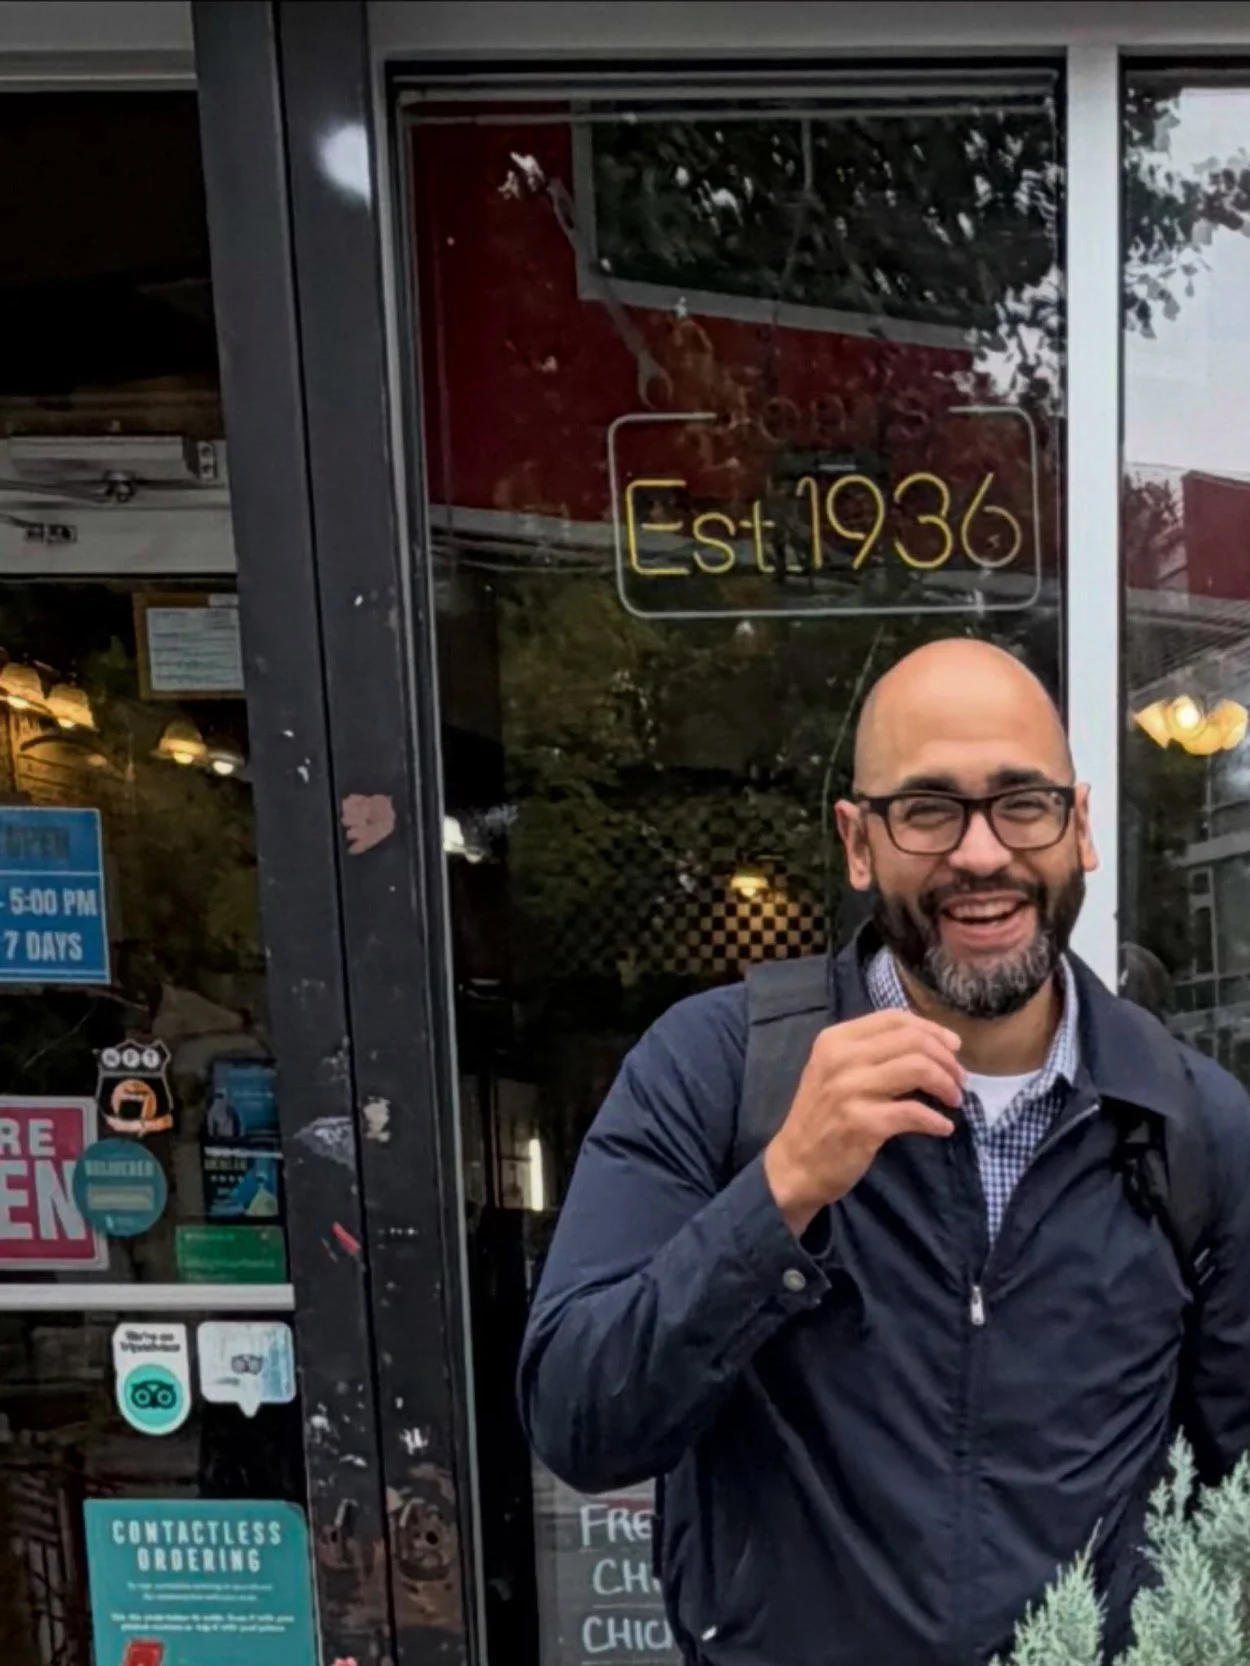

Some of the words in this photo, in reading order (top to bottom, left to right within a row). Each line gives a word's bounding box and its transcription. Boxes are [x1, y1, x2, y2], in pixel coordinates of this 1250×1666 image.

[796, 472, 1022, 570] 1936
[9, 887, 58, 916] 5:00
[63, 890, 98, 917] PM
[3, 931, 19, 960] 7
[26, 931, 84, 962] DAYS
[111, 1519, 283, 1546] CONTACTLESS
[136, 1546, 262, 1573] ORDERING
